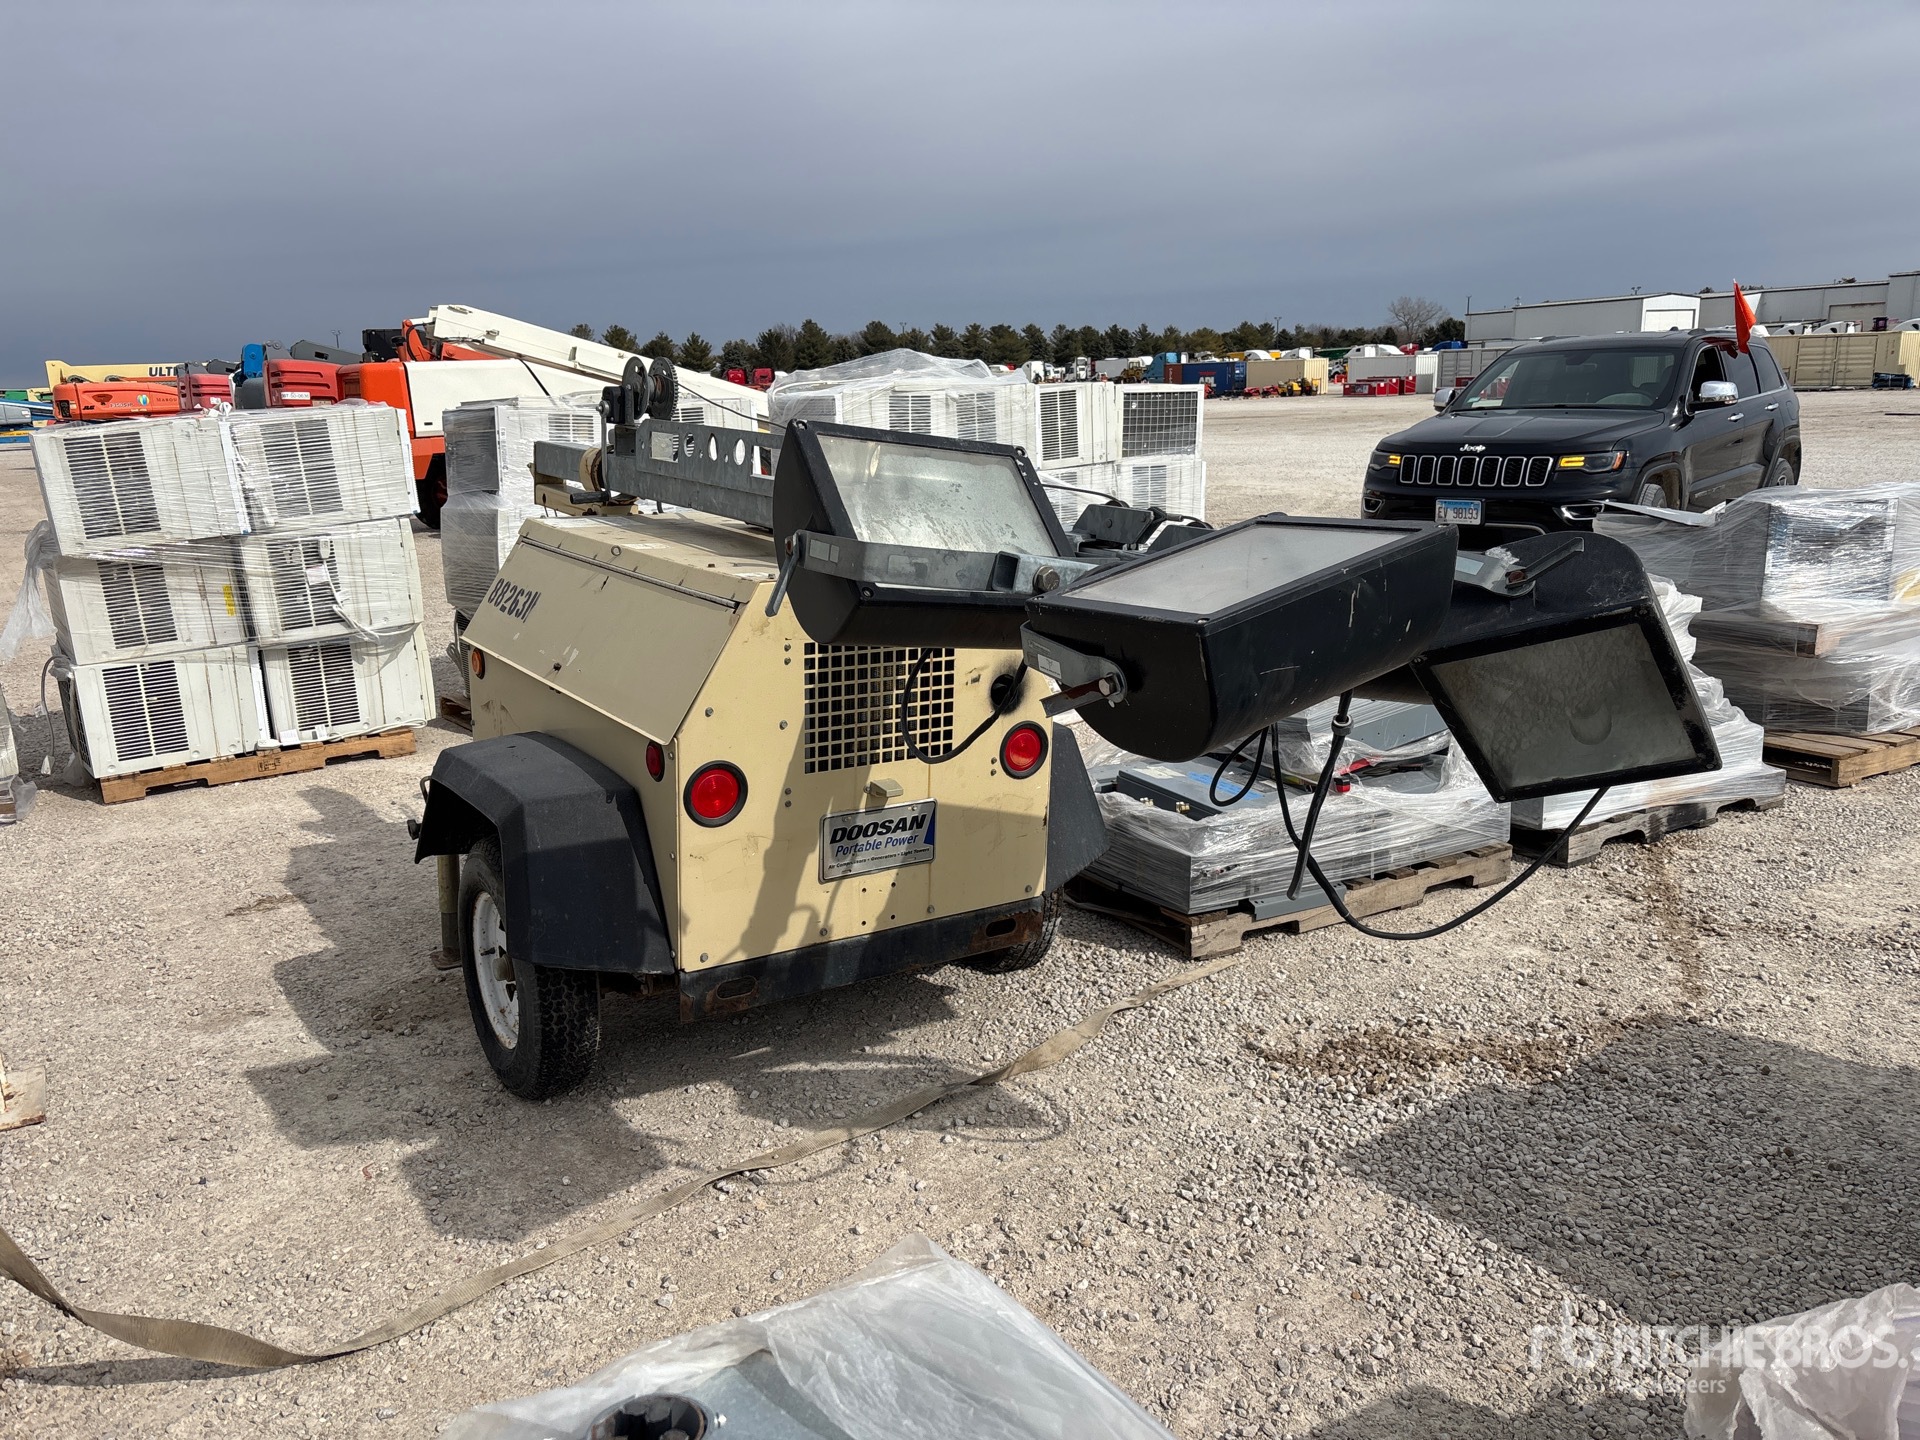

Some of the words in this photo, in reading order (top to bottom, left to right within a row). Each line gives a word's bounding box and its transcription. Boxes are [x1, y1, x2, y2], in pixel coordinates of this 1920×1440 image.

[1459, 444, 1486, 454] Jeep
[1437, 506, 1448, 519] EV
[1452, 507, 1479, 520] 98193
[829, 814, 926, 844] DOOSAN
[835, 838, 882, 858] Portable
[884, 834, 919, 849] Power
[870, 853, 897, 862] Generators
